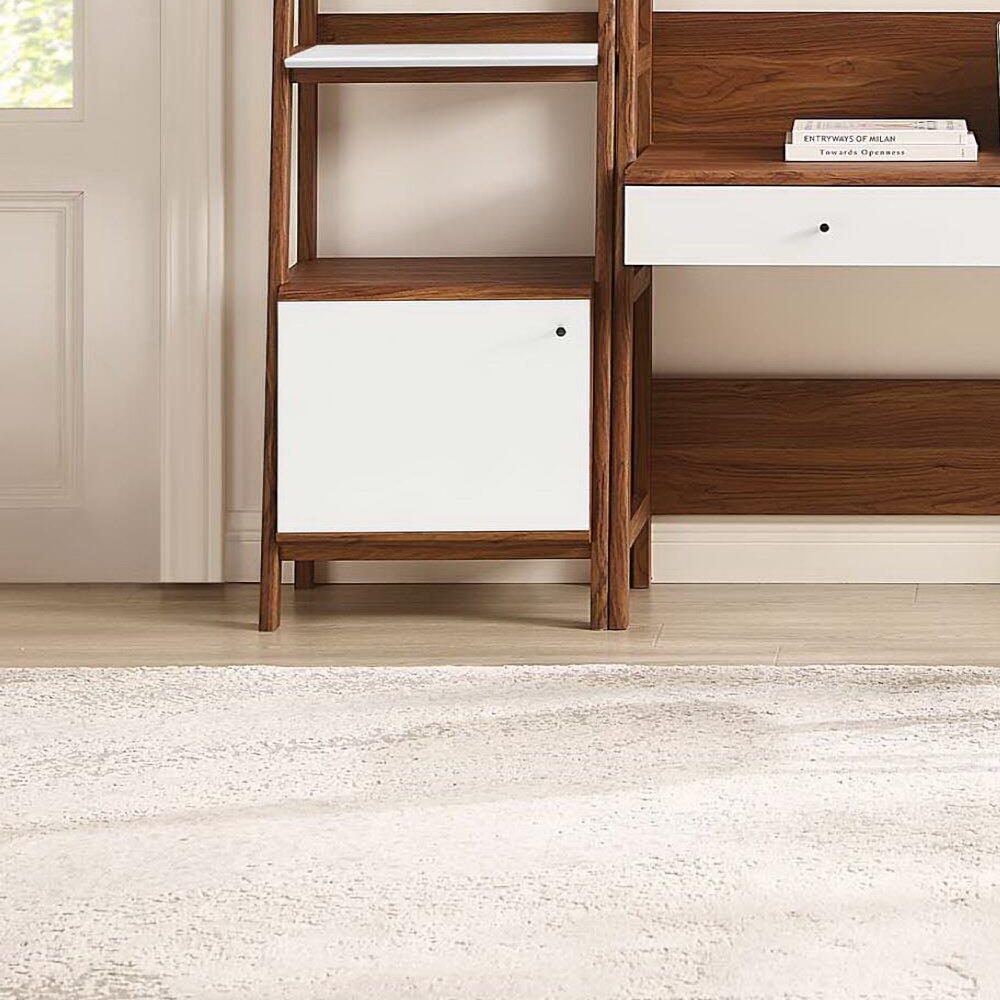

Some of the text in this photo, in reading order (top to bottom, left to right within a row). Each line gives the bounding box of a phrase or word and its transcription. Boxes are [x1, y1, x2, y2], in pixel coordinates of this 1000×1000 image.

[804, 135, 896, 143] ENTRYWAYS OF MILAN
[861, 149, 905, 157] Openness
